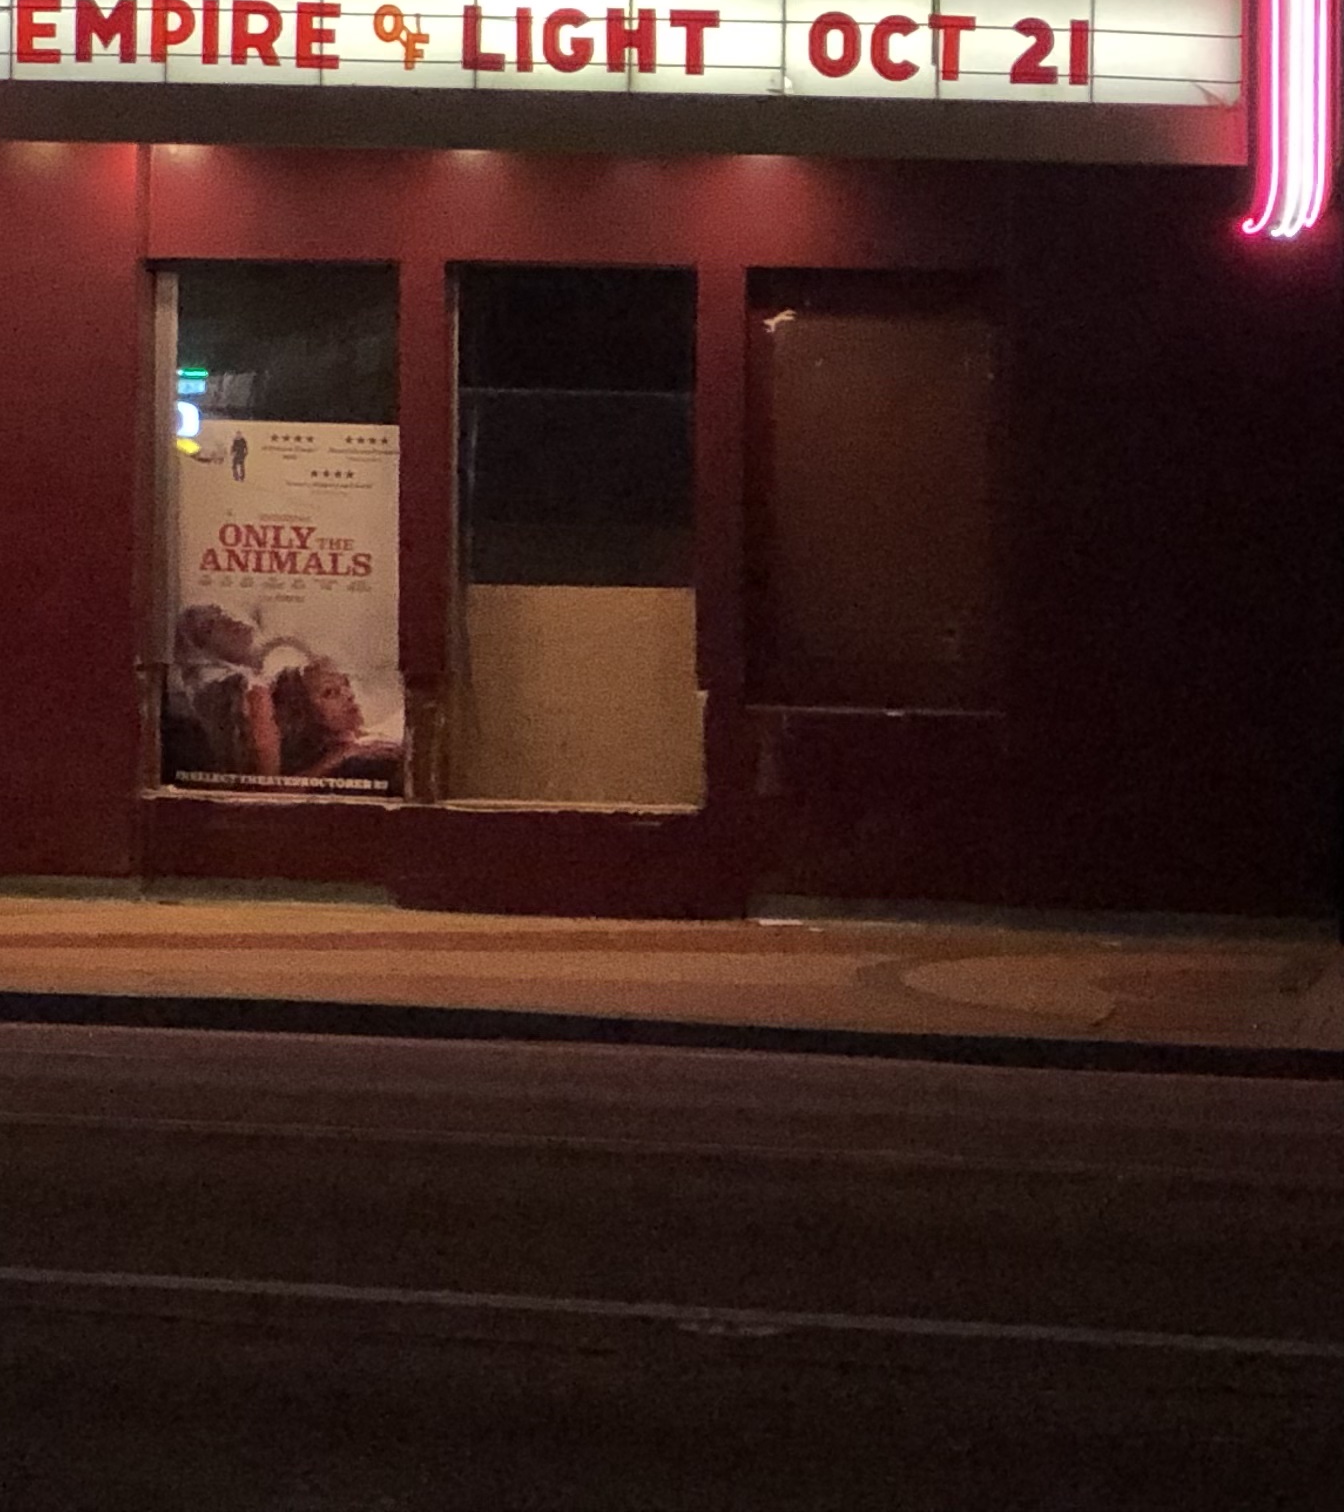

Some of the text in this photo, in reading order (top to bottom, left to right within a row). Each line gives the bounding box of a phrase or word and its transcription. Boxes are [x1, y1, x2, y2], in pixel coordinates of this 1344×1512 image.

[460, 5, 721, 80] LIGHT
[806, 9, 978, 85] OCT
[1009, 15, 1091, 89] 21
[218, 522, 354, 551] ONLY THE
[199, 548, 373, 577] ANIMALS
